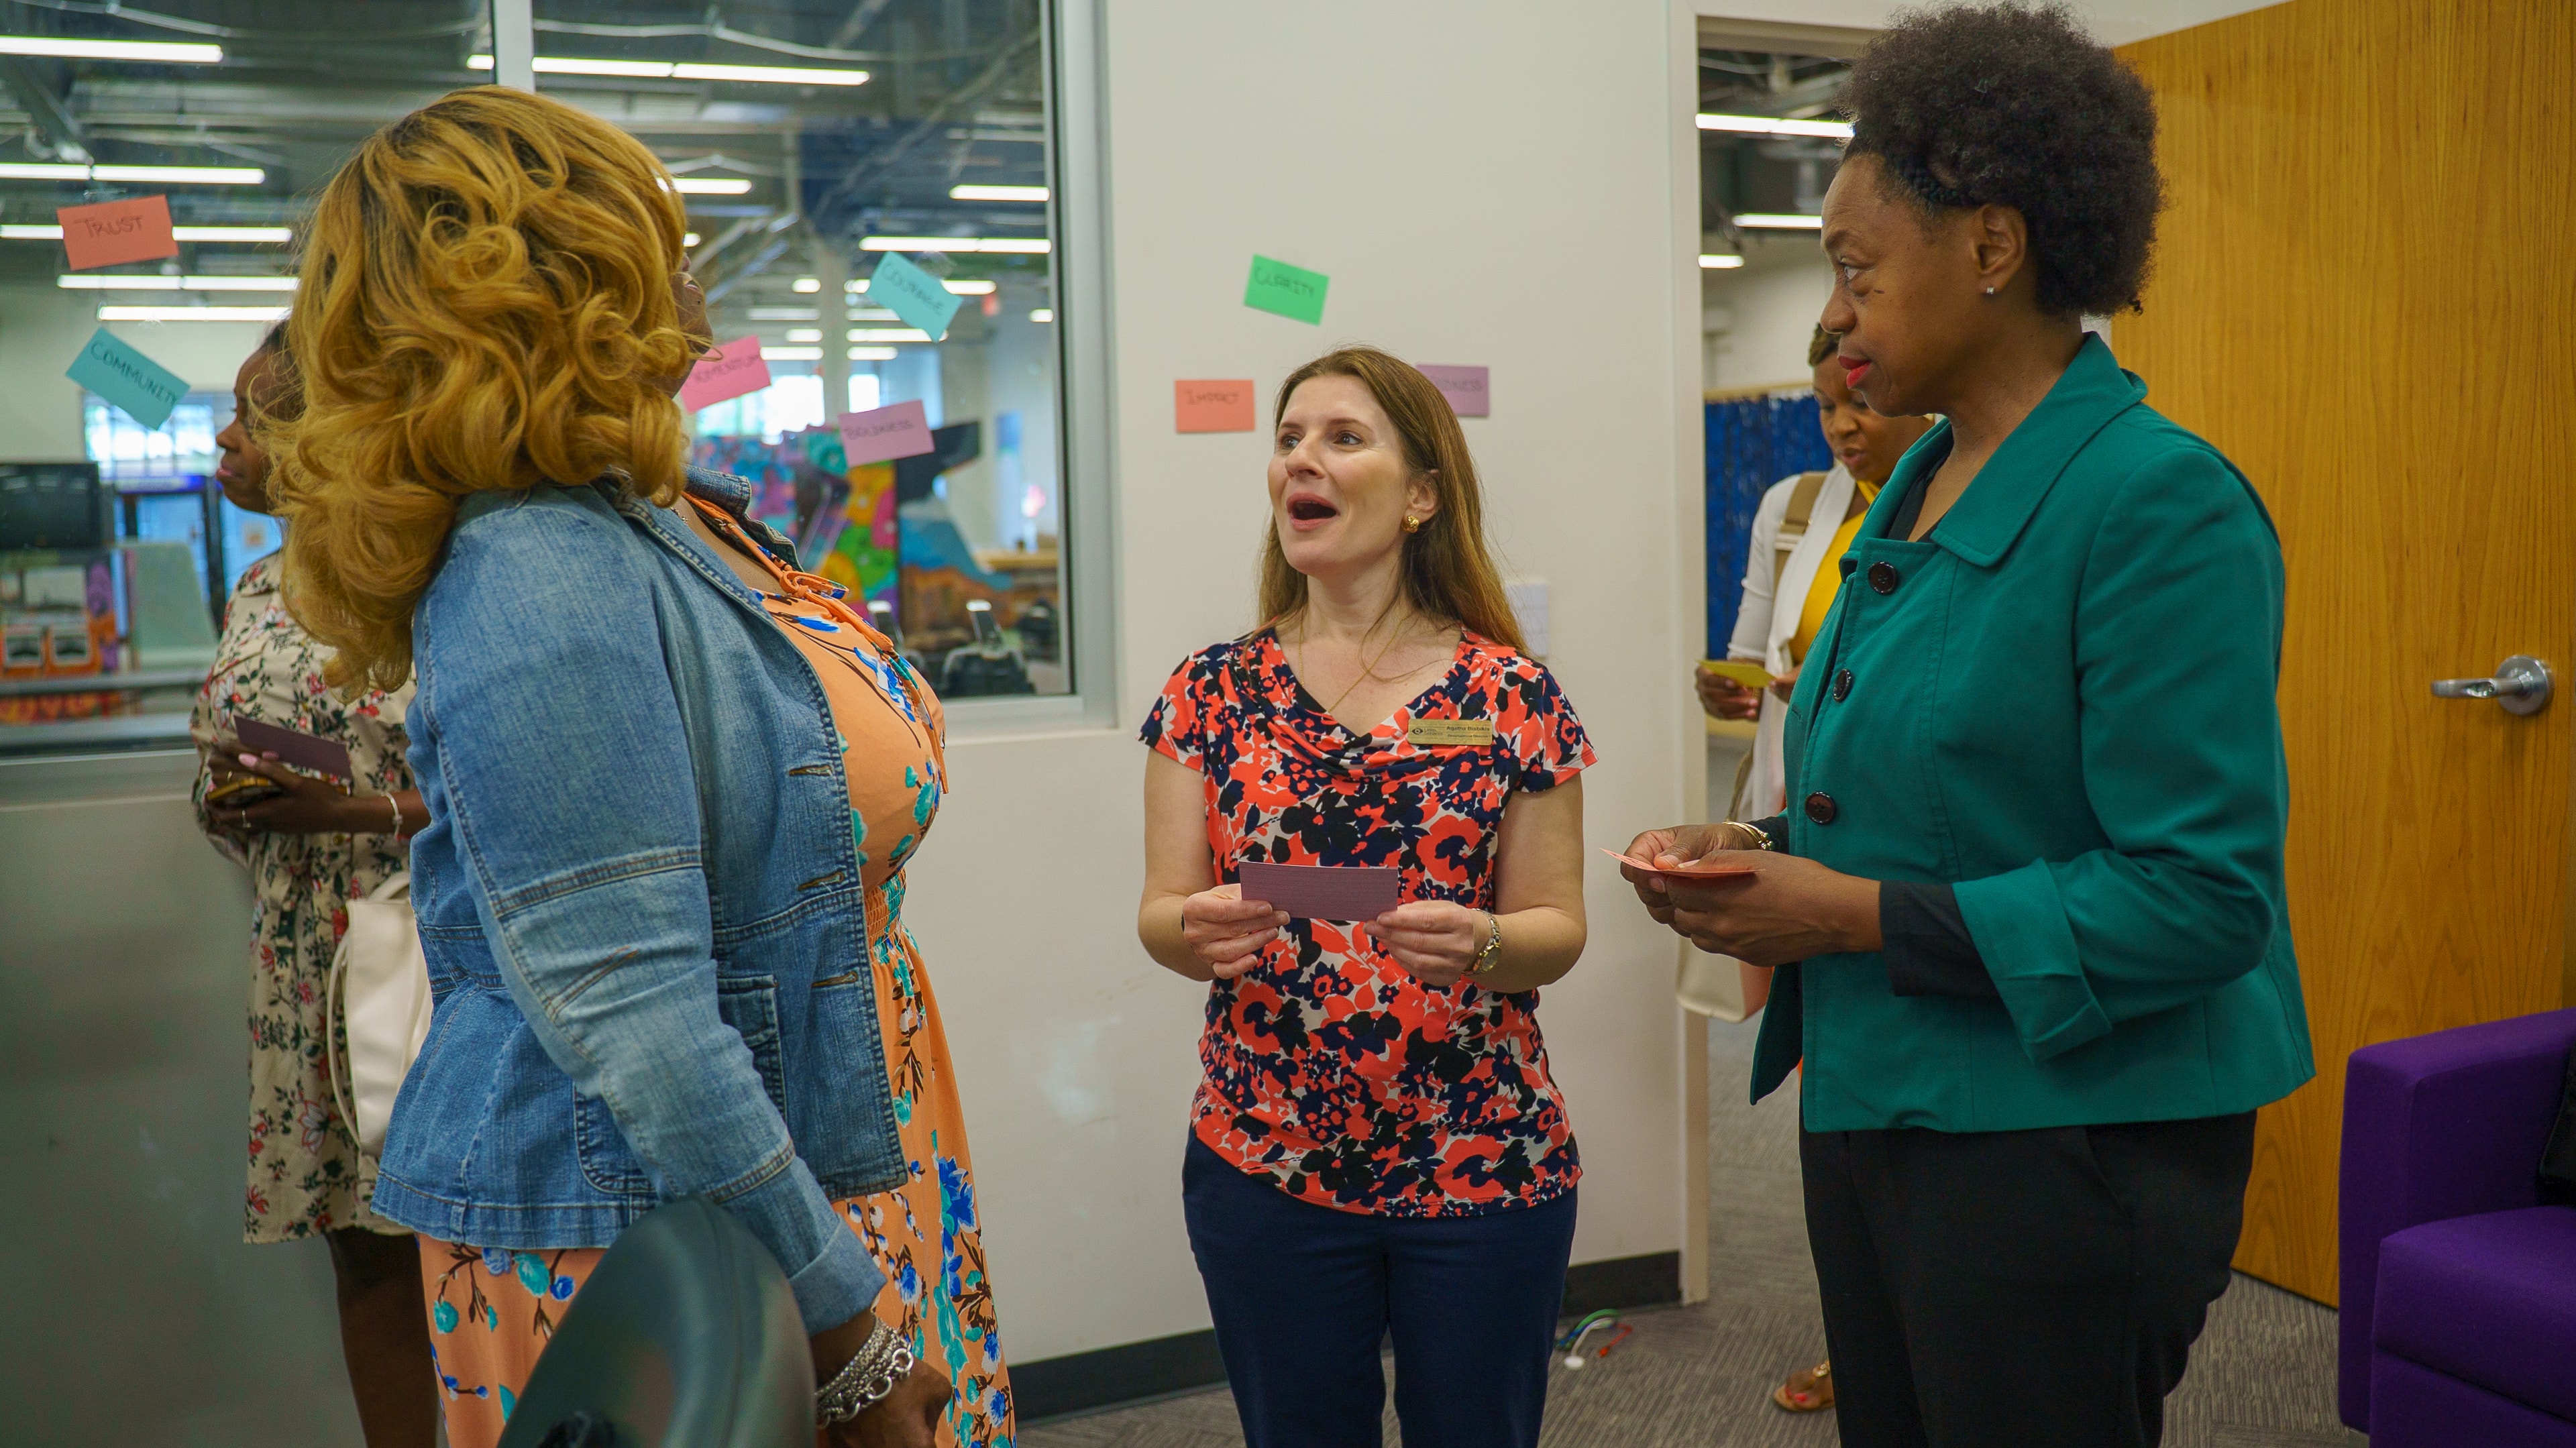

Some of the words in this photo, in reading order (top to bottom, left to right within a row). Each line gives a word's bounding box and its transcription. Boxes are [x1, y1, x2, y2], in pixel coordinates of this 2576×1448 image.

[73, 215, 143, 238] TRUST
[1253, 266, 1315, 298] CLARITY
[90, 340, 178, 406] COMMUNITY
[694, 353, 760, 384] OMENTUM
[1183, 388, 1240, 406] IMPACT
